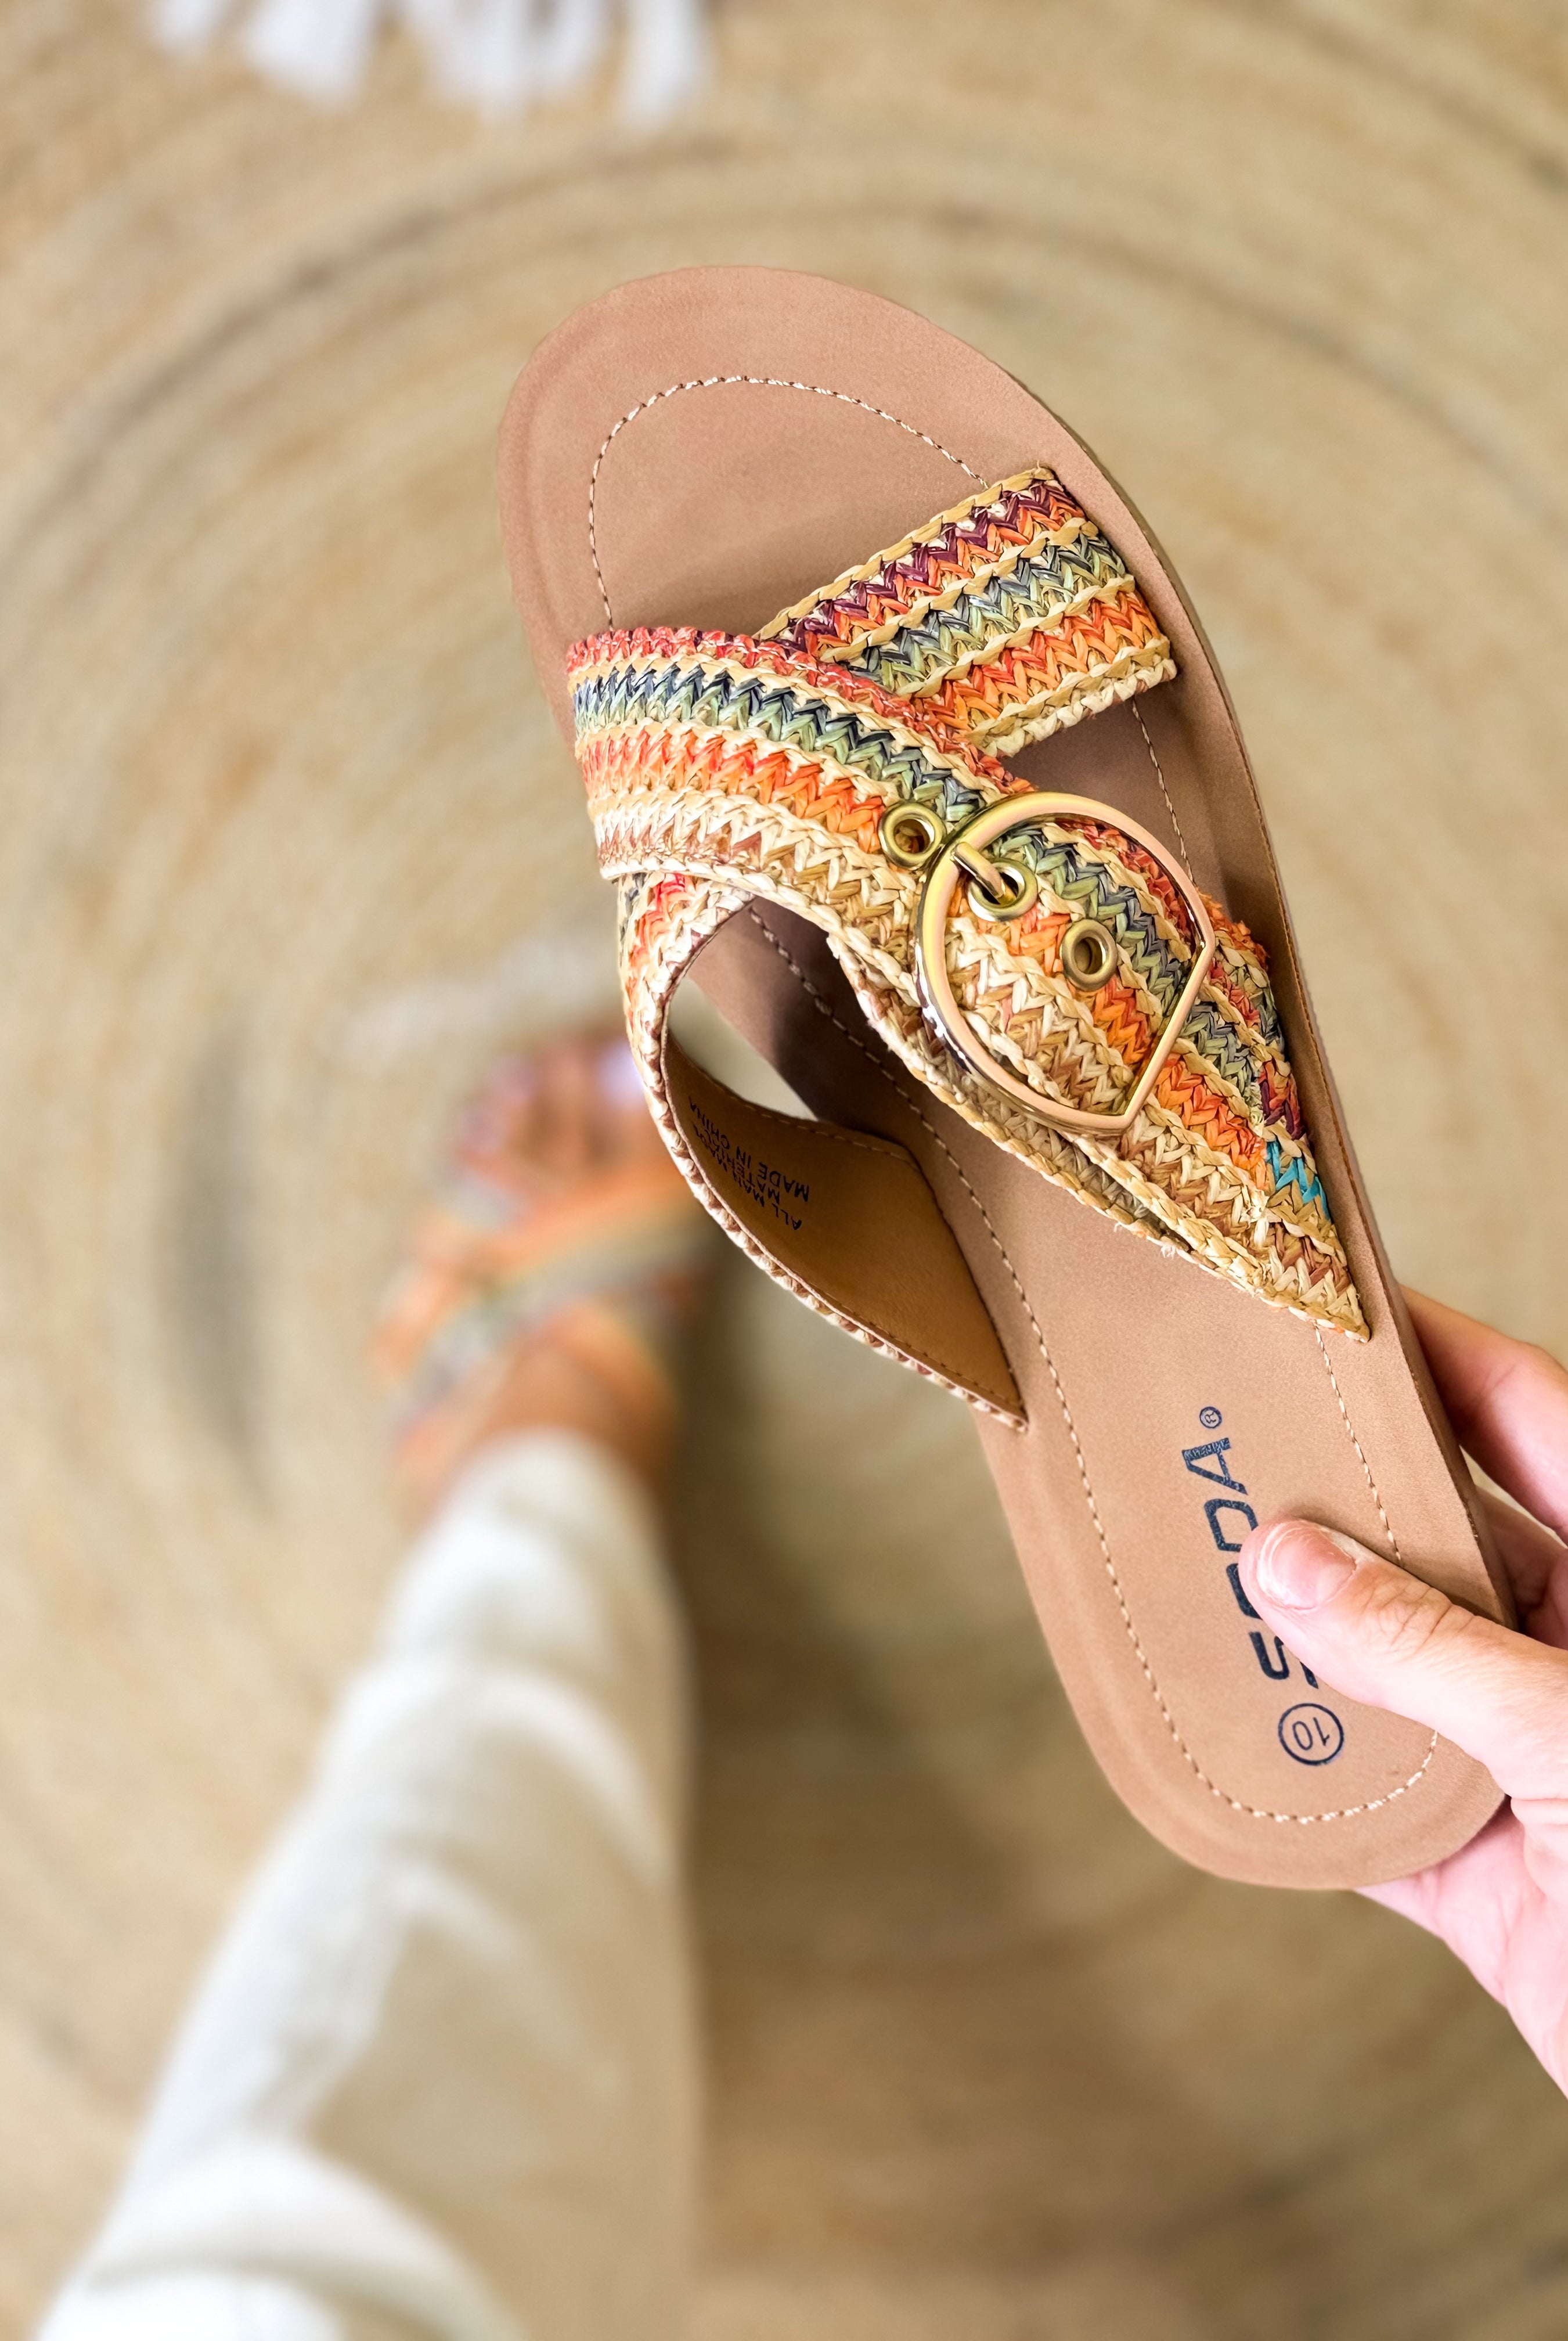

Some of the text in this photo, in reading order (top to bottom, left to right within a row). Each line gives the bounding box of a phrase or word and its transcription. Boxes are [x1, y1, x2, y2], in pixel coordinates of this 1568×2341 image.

[689, 1096, 810, 1202] MADE IN CHINA
[772, 1202, 802, 1230] ALL
[1292, 1716, 1330, 1751] 10
